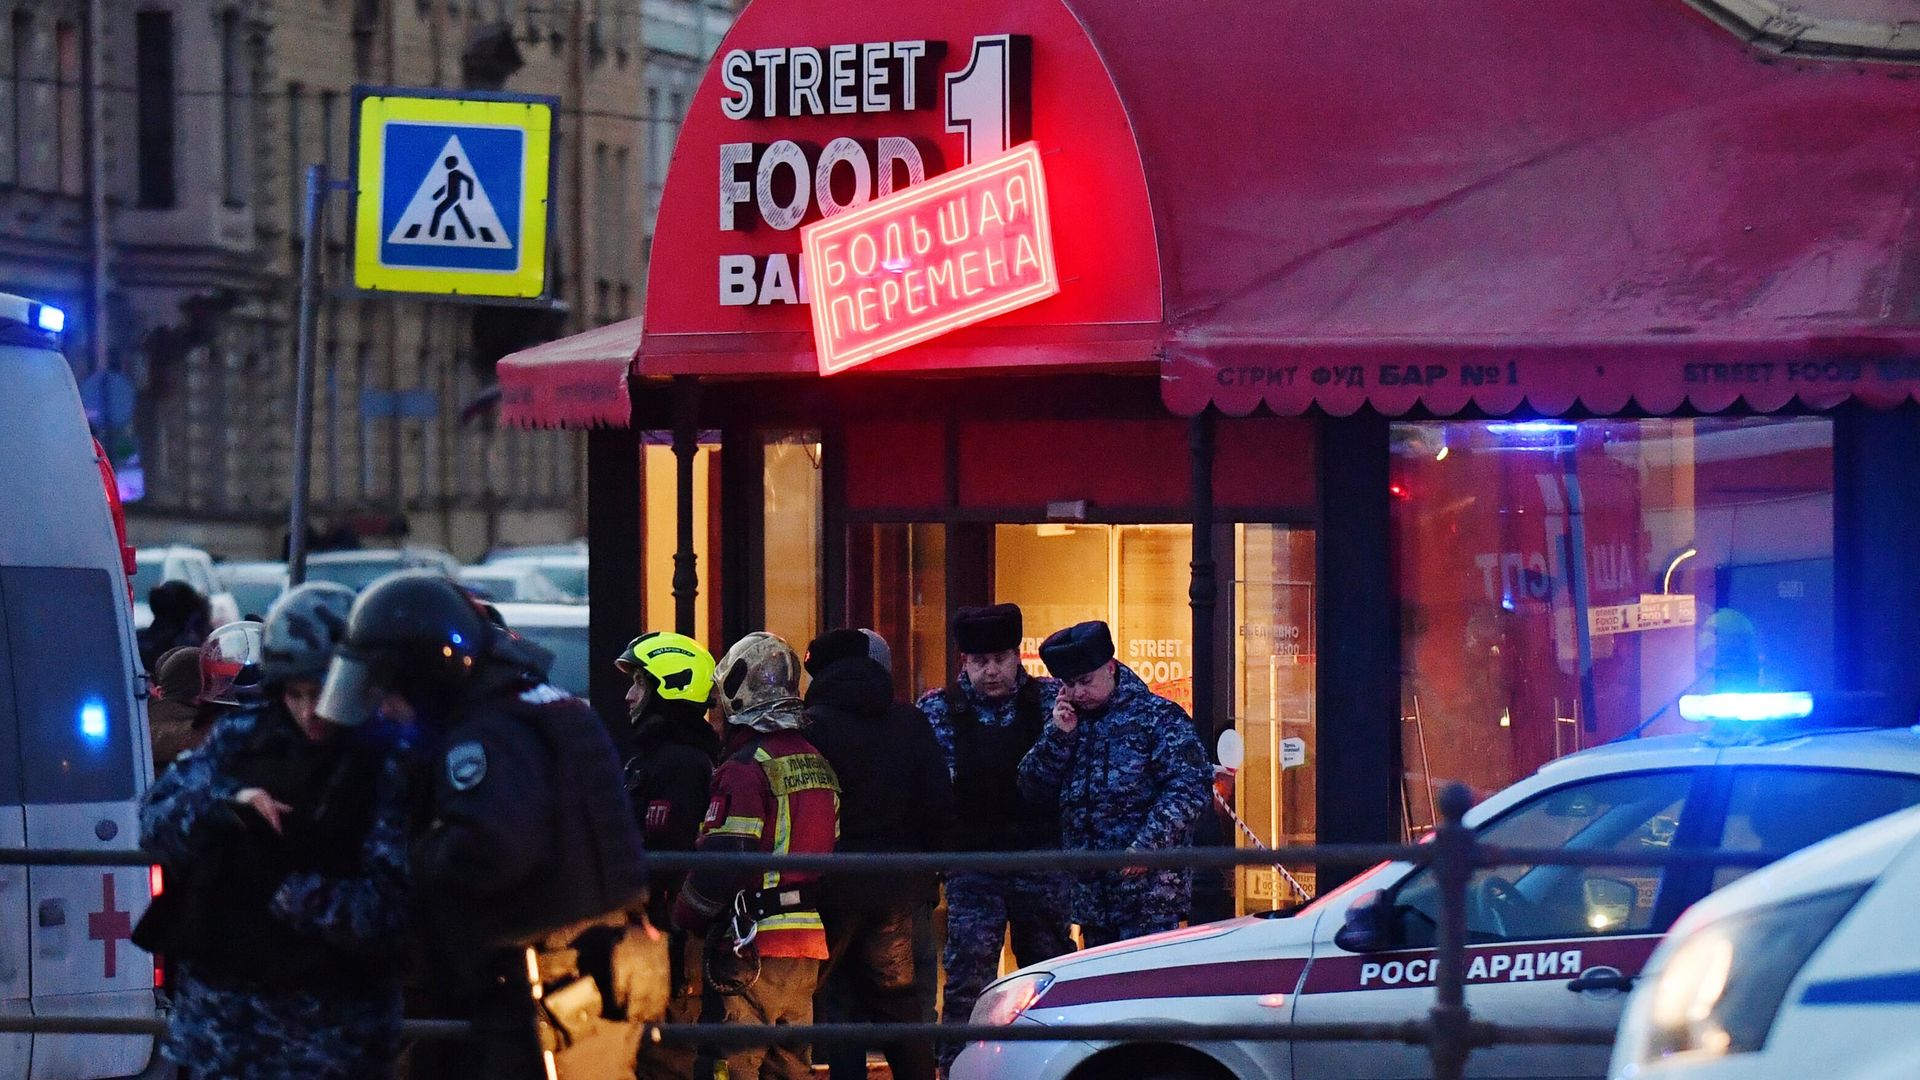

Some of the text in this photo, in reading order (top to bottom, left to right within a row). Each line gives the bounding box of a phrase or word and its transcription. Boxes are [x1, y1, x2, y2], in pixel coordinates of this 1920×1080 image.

[720, 39, 926, 121] STREET
[944, 34, 1011, 165] 1
[719, 136, 925, 231] FOOD
[824, 175, 1029, 287] БОЛЬШАЯ
[830, 234, 1039, 339] ПЕРЕМЕНА
[1216, 366, 1298, 386] СТРИТ
[1310, 365, 1365, 388] ФУД
[1378, 365, 1448, 385] БАР
[1683, 362, 1774, 382] STREET
[1130, 639, 1183, 657] STREET
[1130, 660, 1183, 684] FOOD
[1360, 950, 1583, 986] РОСГАРДИЯ
